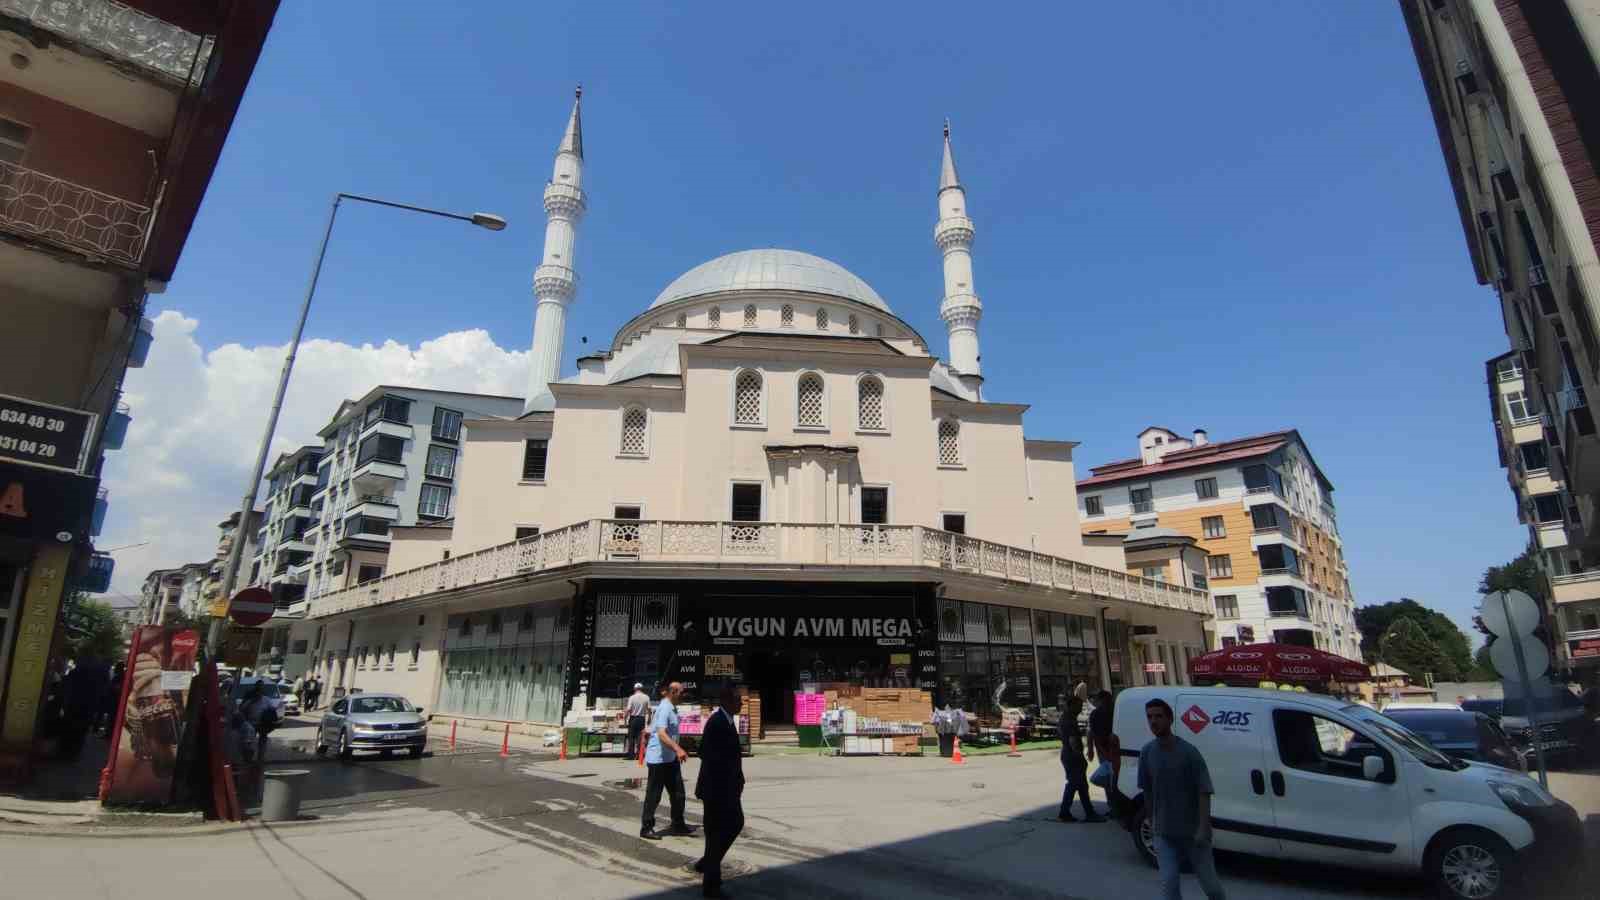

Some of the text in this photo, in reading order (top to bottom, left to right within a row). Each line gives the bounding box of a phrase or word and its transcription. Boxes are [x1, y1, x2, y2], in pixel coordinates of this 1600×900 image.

[28, 415, 46, 428] 48
[47, 419, 65, 432] 30
[19, 440, 37, 454] 04
[38, 444, 57, 457] 20
[708, 617, 913, 637] UYGUN AVM MEGA
[1213, 711, 1253, 726] aras
